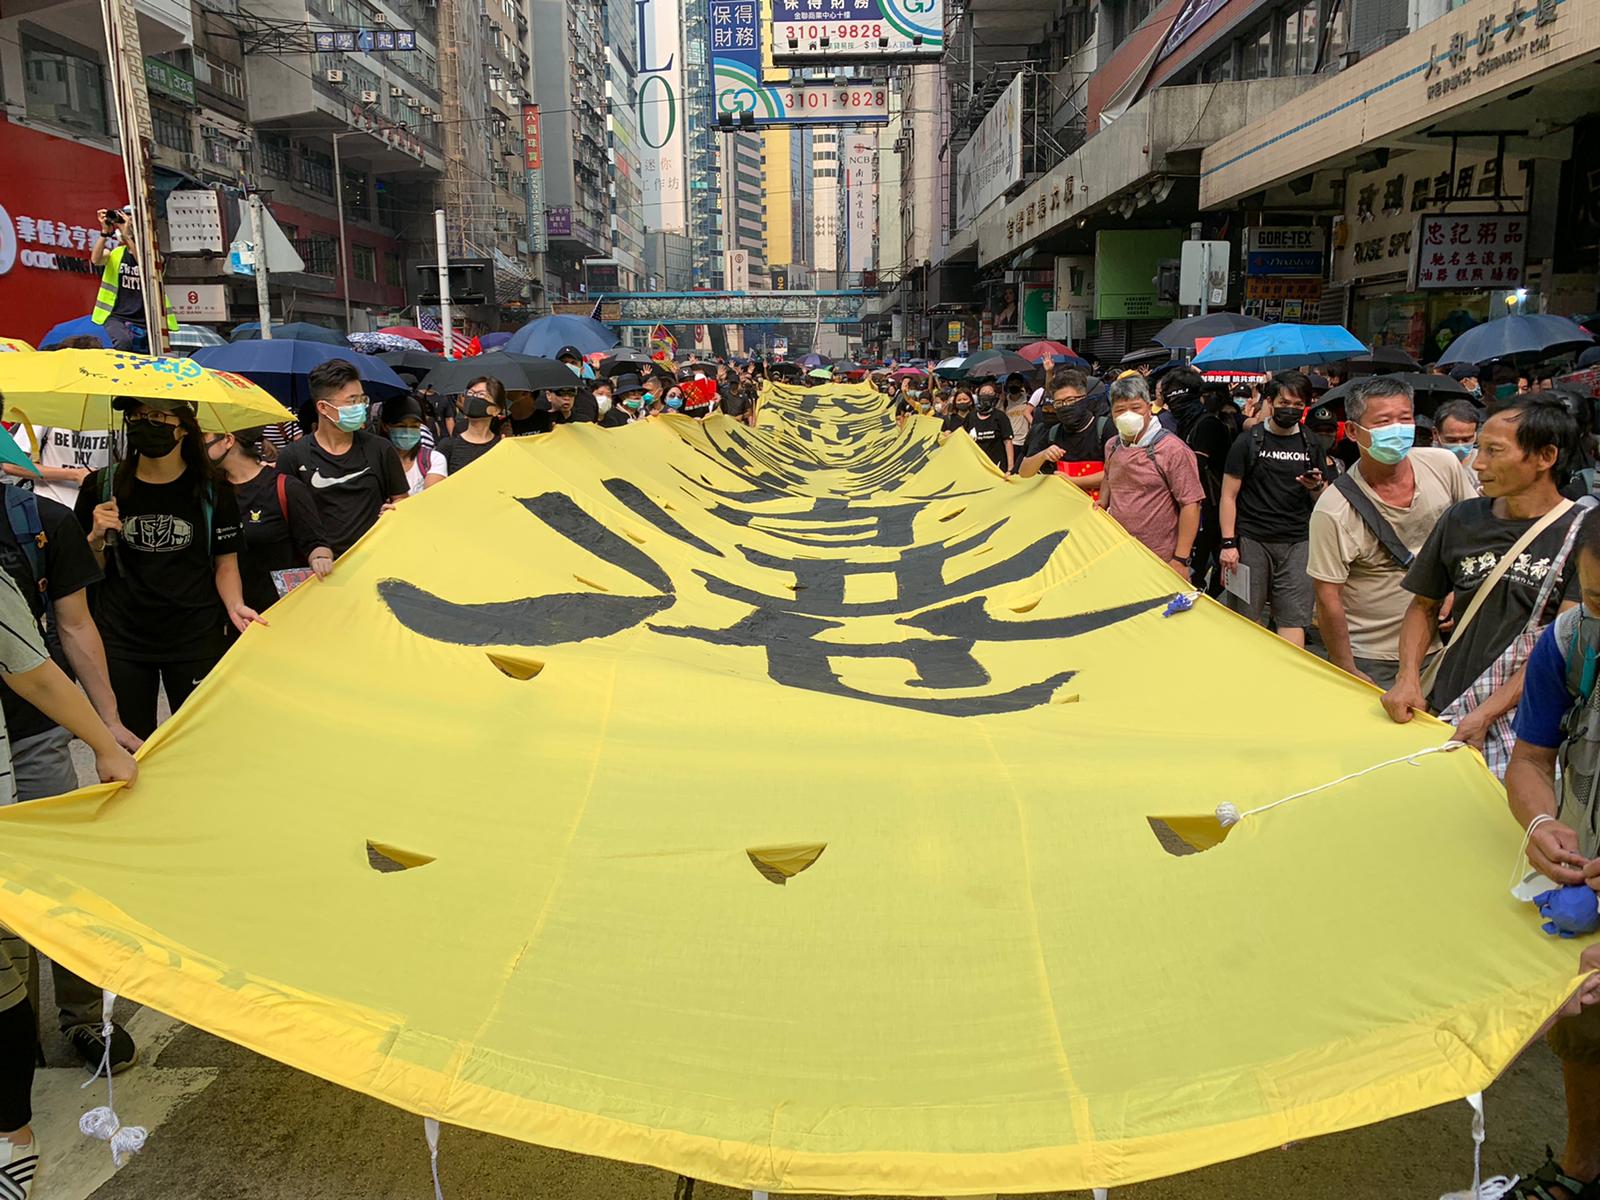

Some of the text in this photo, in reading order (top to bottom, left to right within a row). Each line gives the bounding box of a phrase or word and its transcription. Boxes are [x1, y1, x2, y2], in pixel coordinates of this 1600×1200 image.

[713, 6, 753, 24] 保得
[714, 27, 754, 47] 財務
[786, 24, 882, 39] 3101-9828
[786, 92, 885, 109] 3101-9828
[644, 157, 672, 173] 迷你
[850, 156, 870, 165] NCB
[643, 176, 680, 191] 工作坊
[1258, 230, 1313, 246] GORE-TEX
[1425, 222, 1522, 246] 忠記粥品
[20, 248, 58, 270] OCBC
[1430, 251, 1513, 266] 馳名生滾粥
[122, 275, 140, 290] CITY
[1420, 268, 1448, 282] 油器
[54, 432, 69, 447] BE
[75, 451, 92, 465] MY
